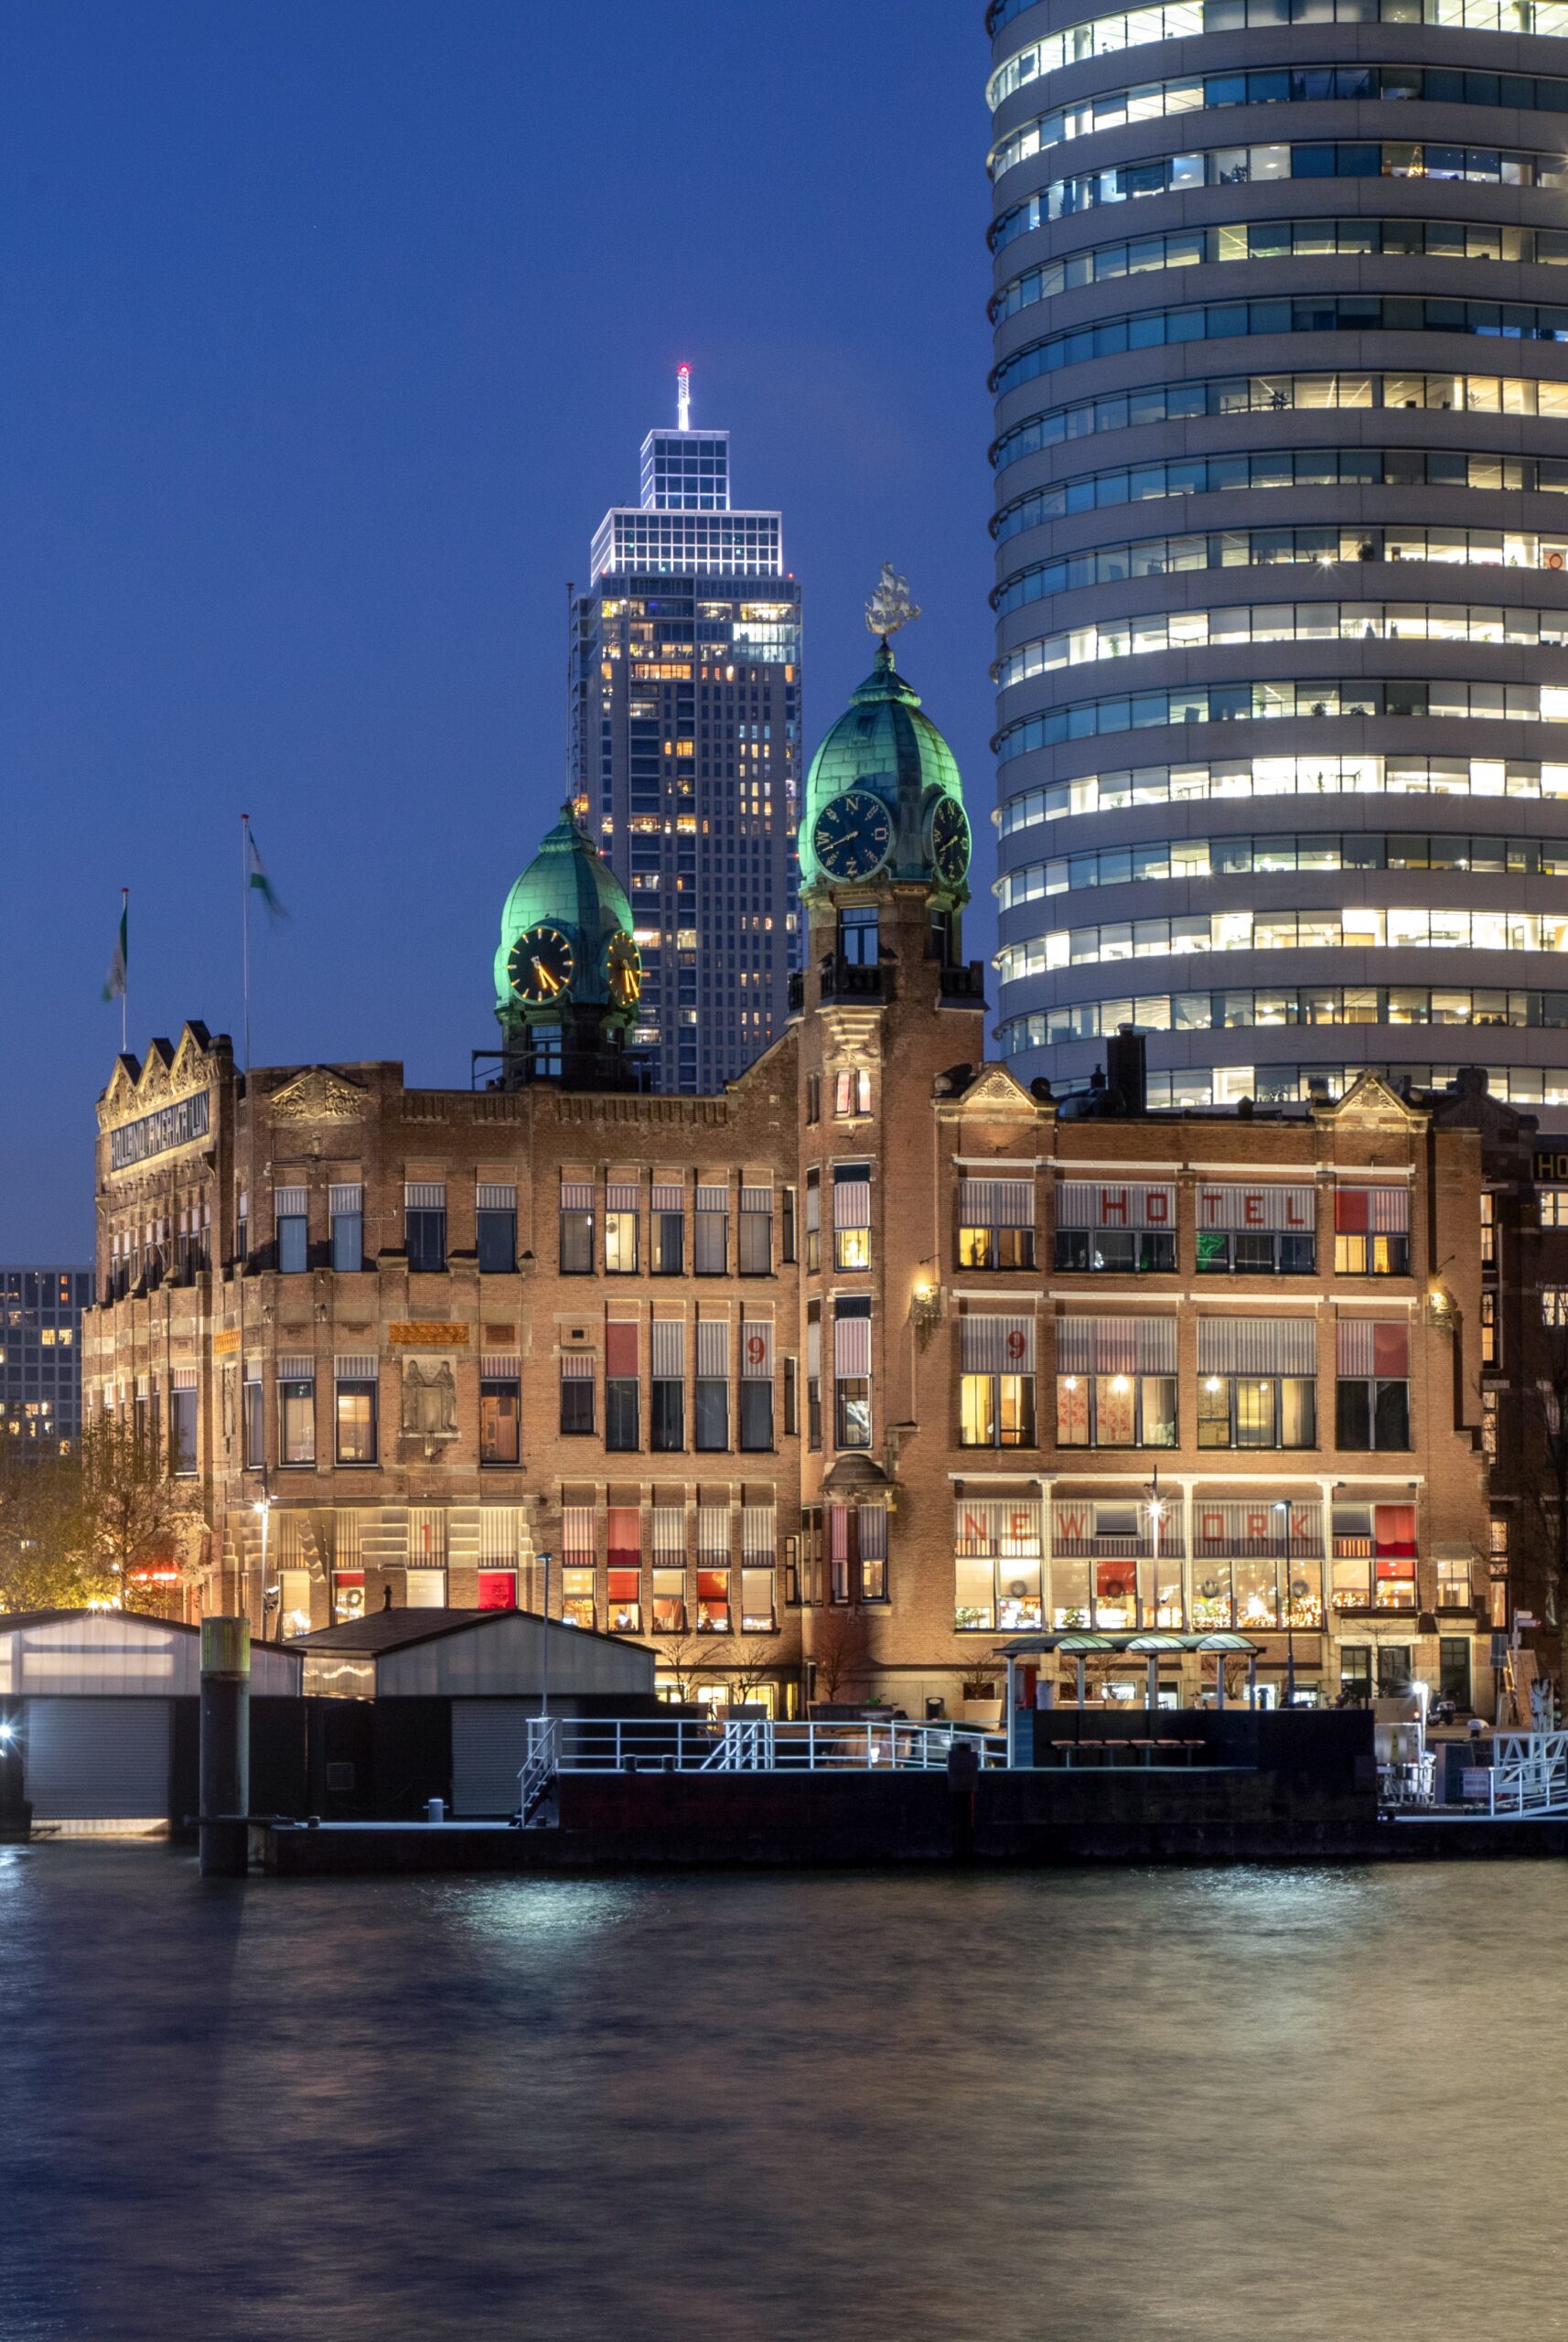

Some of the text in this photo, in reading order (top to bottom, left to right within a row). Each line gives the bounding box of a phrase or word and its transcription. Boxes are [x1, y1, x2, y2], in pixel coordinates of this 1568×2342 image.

[844, 796, 860, 811] N
[947, 800, 955, 816] N
[845, 860, 858, 876] Z
[112, 1121, 146, 1170] HOLLAND
[148, 1101, 188, 1155] AMERIKA
[1101, 1189, 1305, 1225] HOTEL
[747, 1336, 765, 1365] 9
[1008, 1330, 1026, 1359] 9
[419, 1523, 431, 1552] 1
[964, 1512, 1310, 1546] NEW YORK
